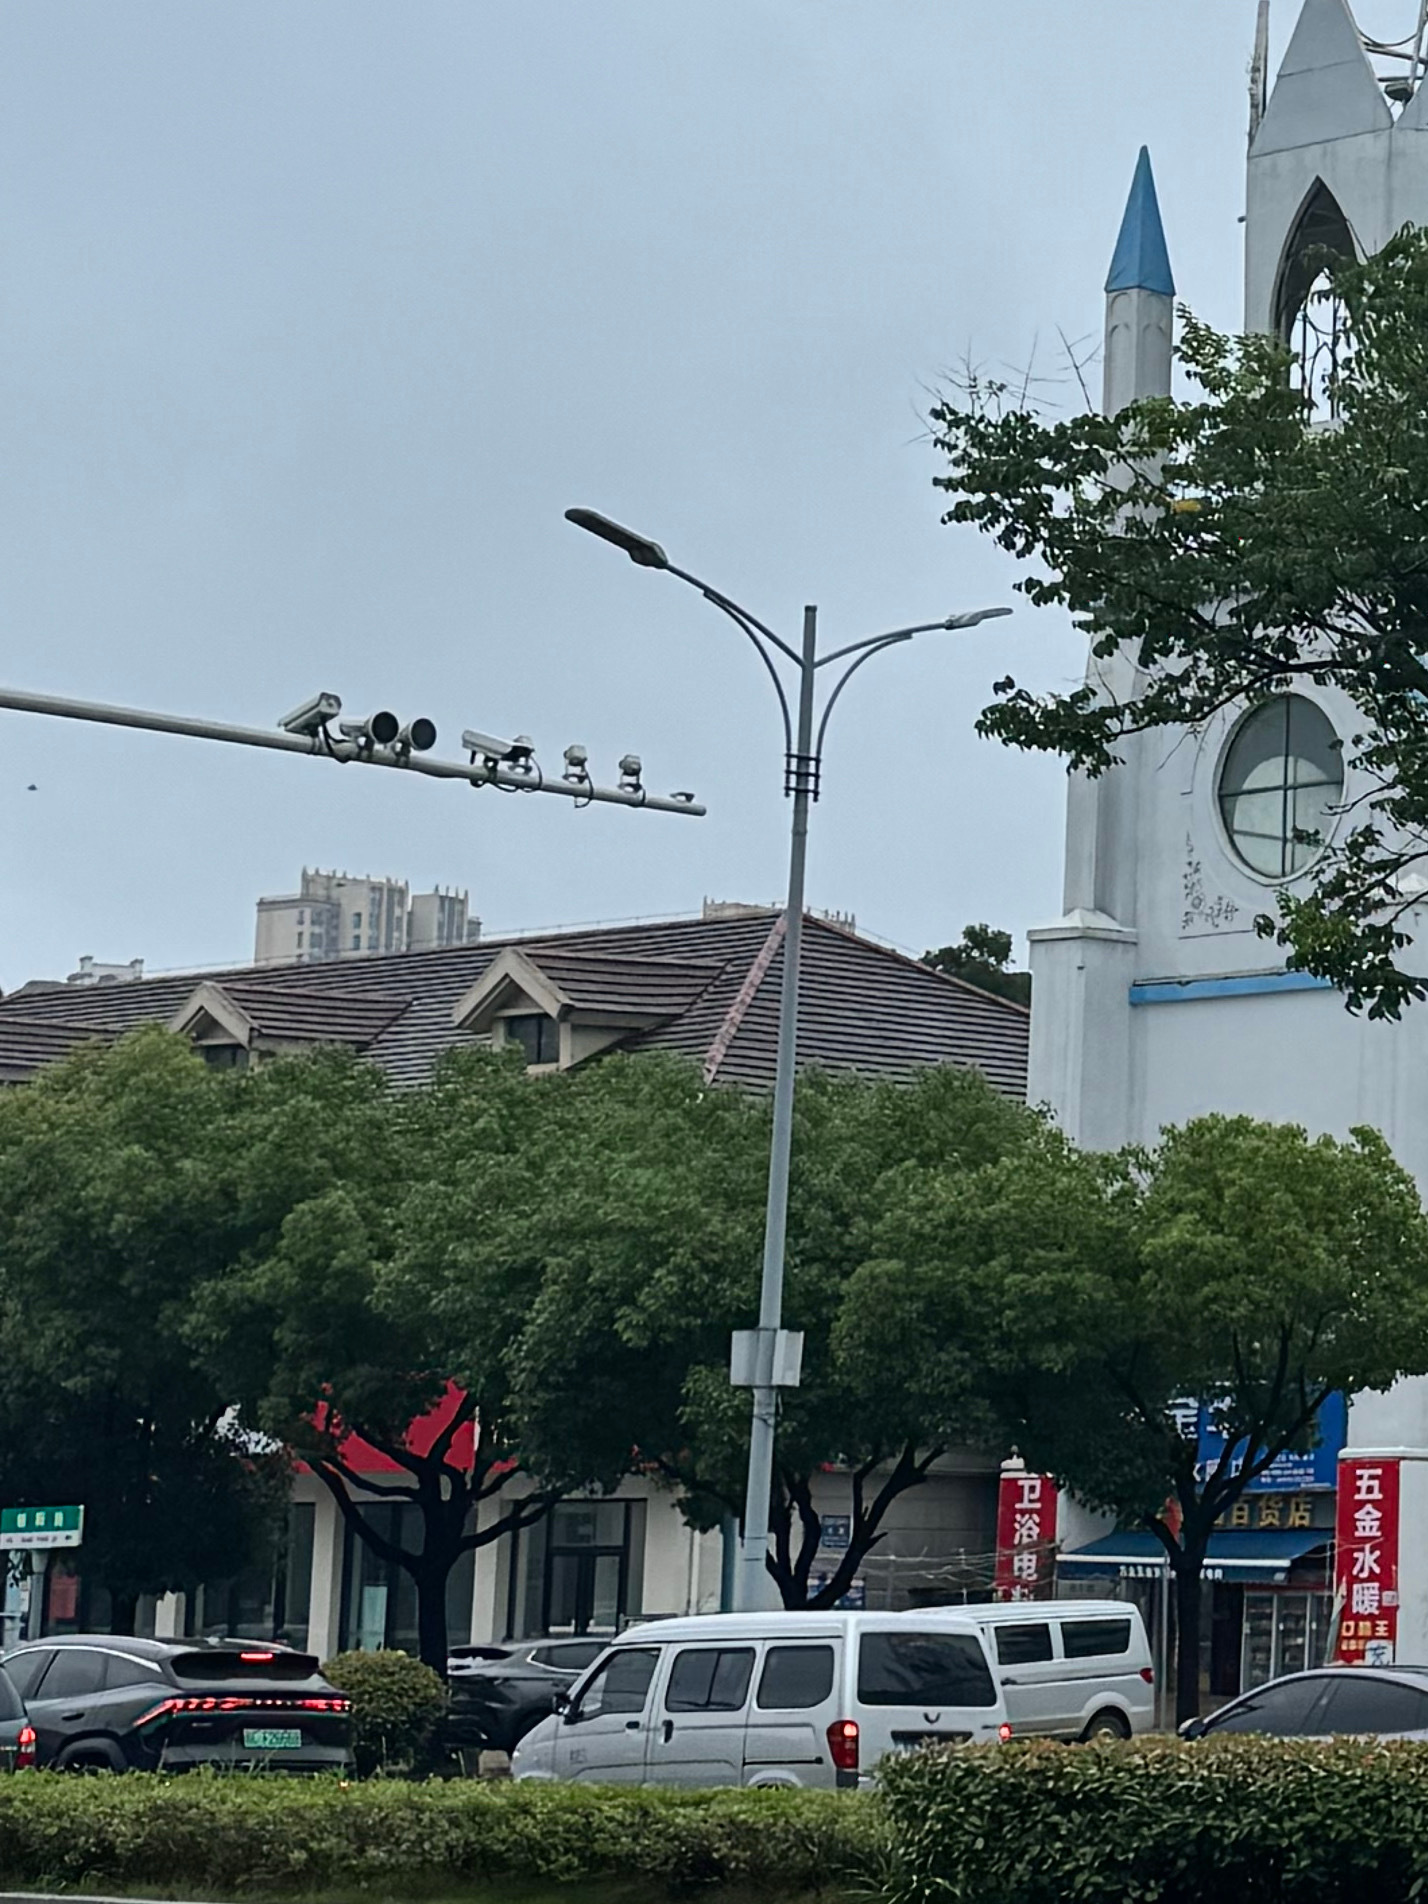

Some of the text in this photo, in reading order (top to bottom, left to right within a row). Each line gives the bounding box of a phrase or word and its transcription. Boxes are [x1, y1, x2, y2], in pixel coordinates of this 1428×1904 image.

[1213, 1496, 1312, 1527] 百货店
[1352, 1468, 1383, 1615] 五金水暖
